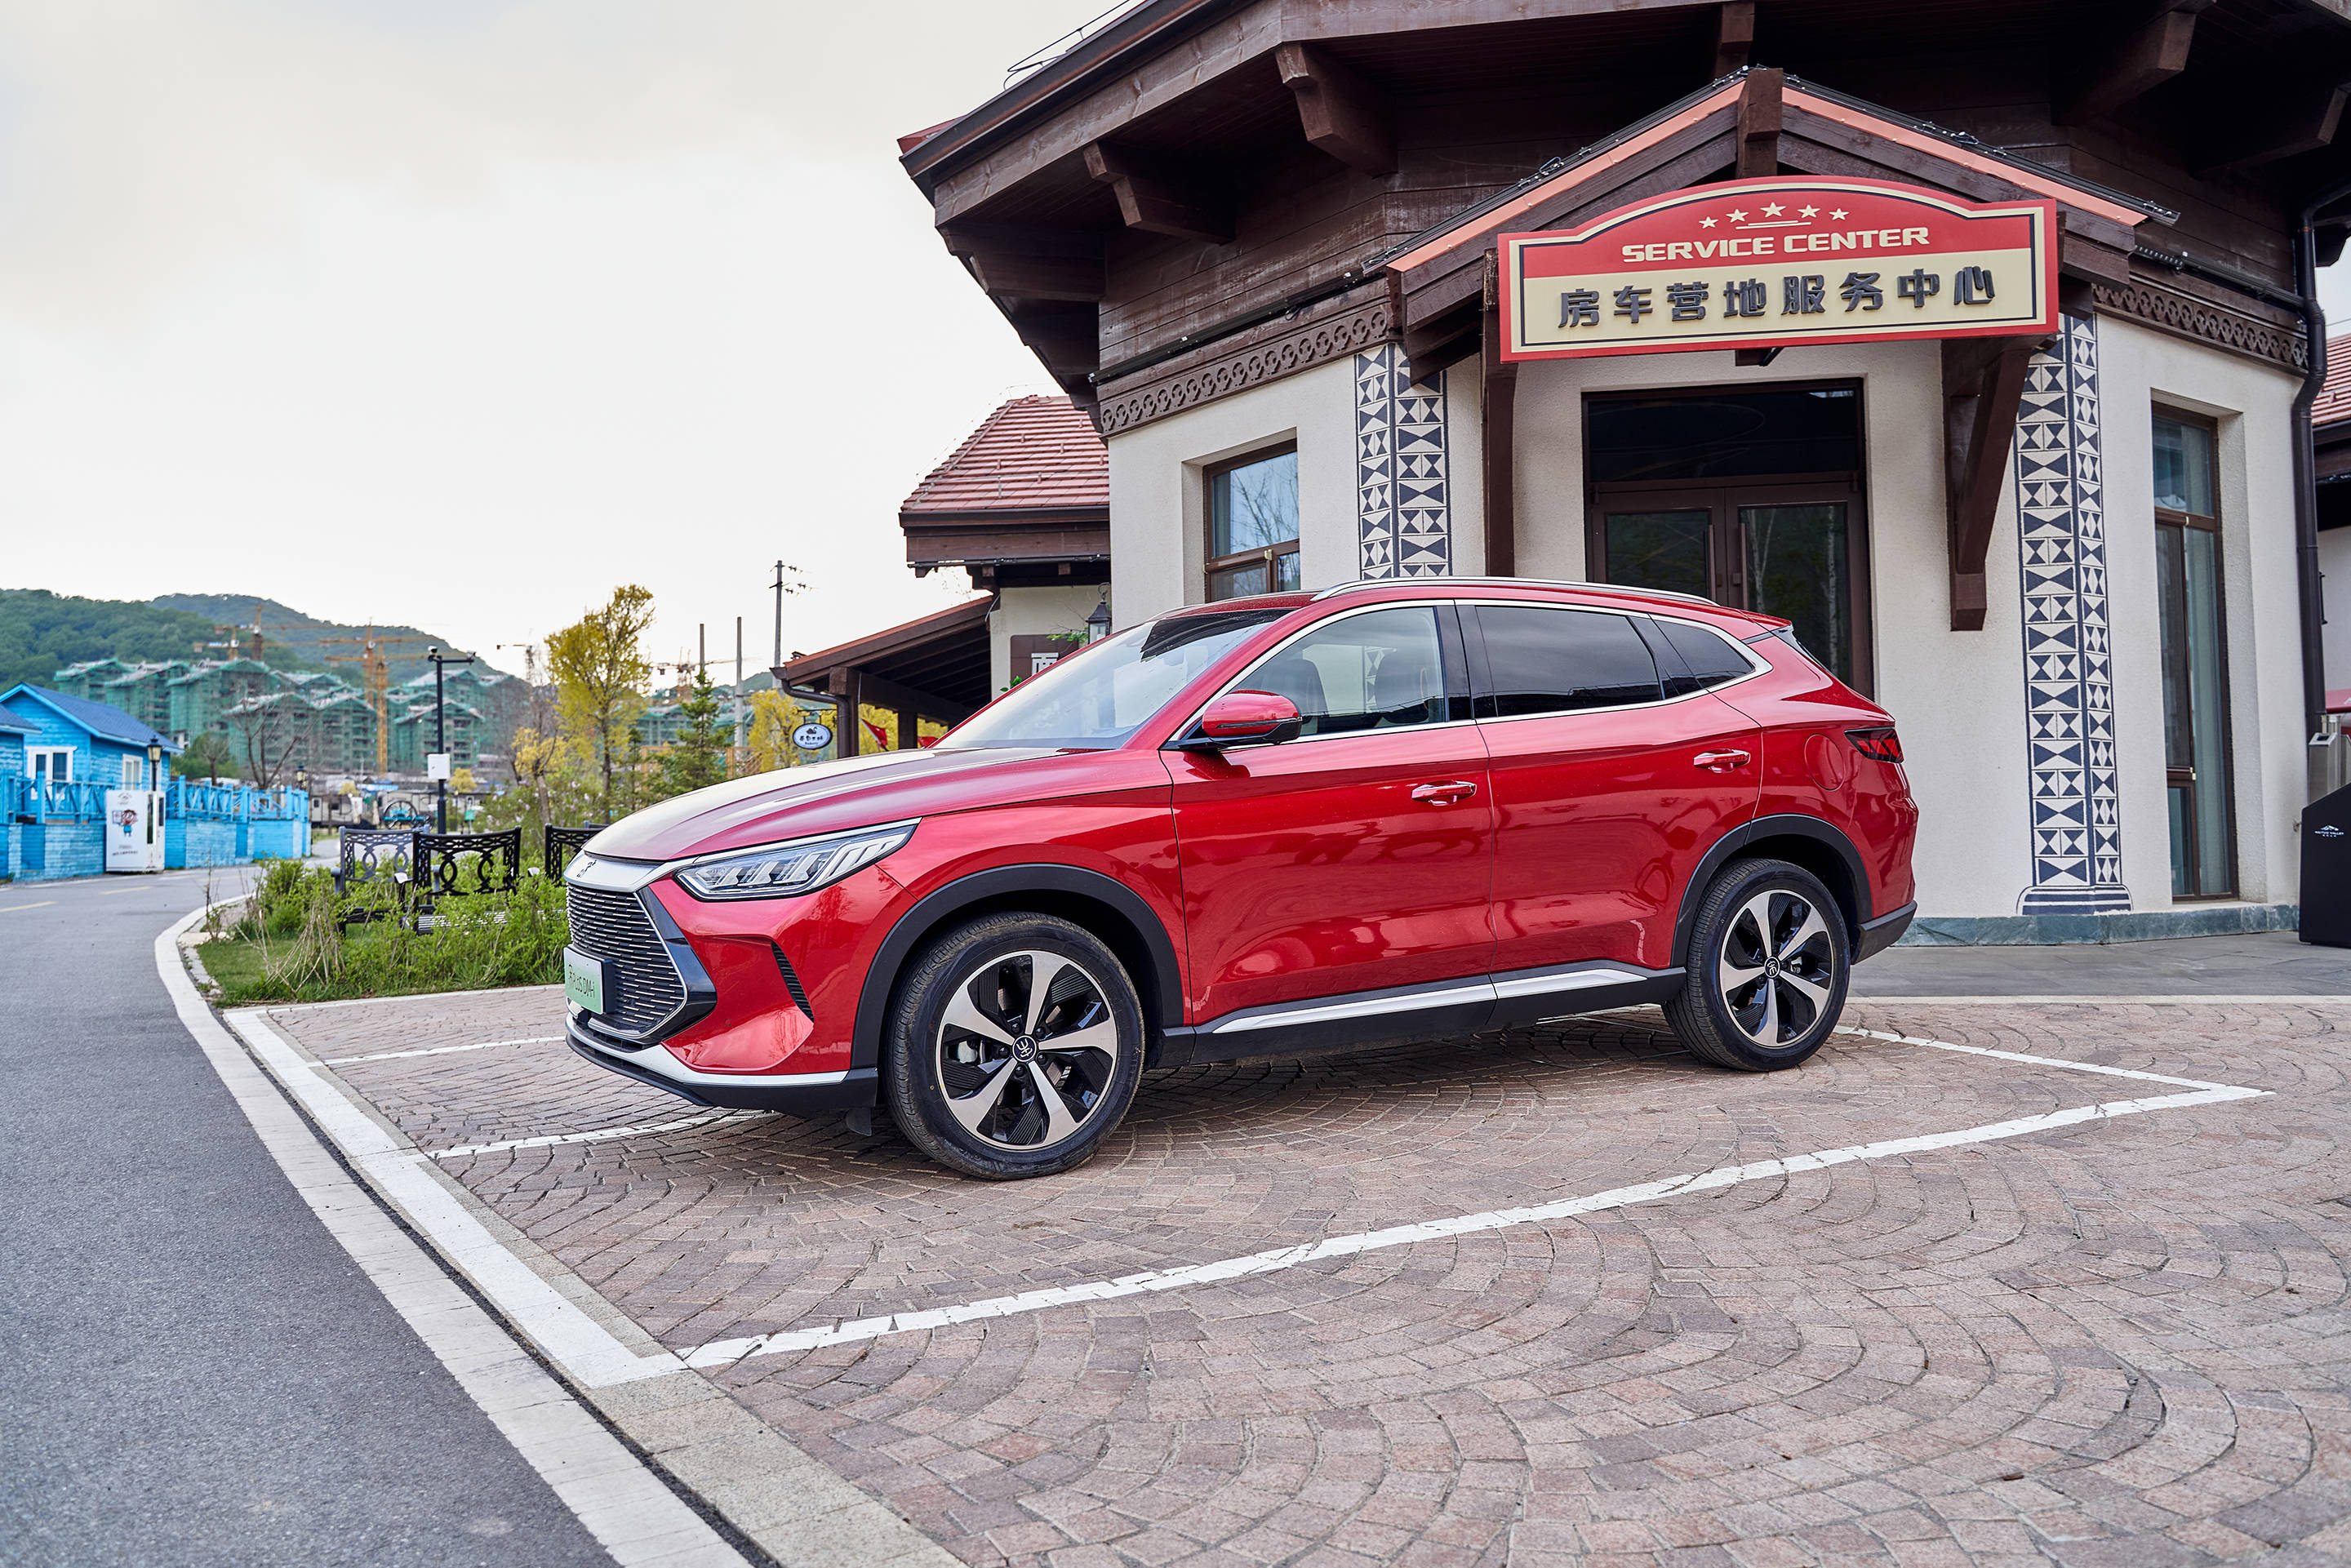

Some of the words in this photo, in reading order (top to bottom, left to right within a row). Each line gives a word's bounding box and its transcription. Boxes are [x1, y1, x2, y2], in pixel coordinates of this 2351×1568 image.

[1622, 237, 1775, 263] SERVICE
[1784, 227, 1930, 253] CENTER
[1558, 266, 1997, 328] 房车营地服务中心
